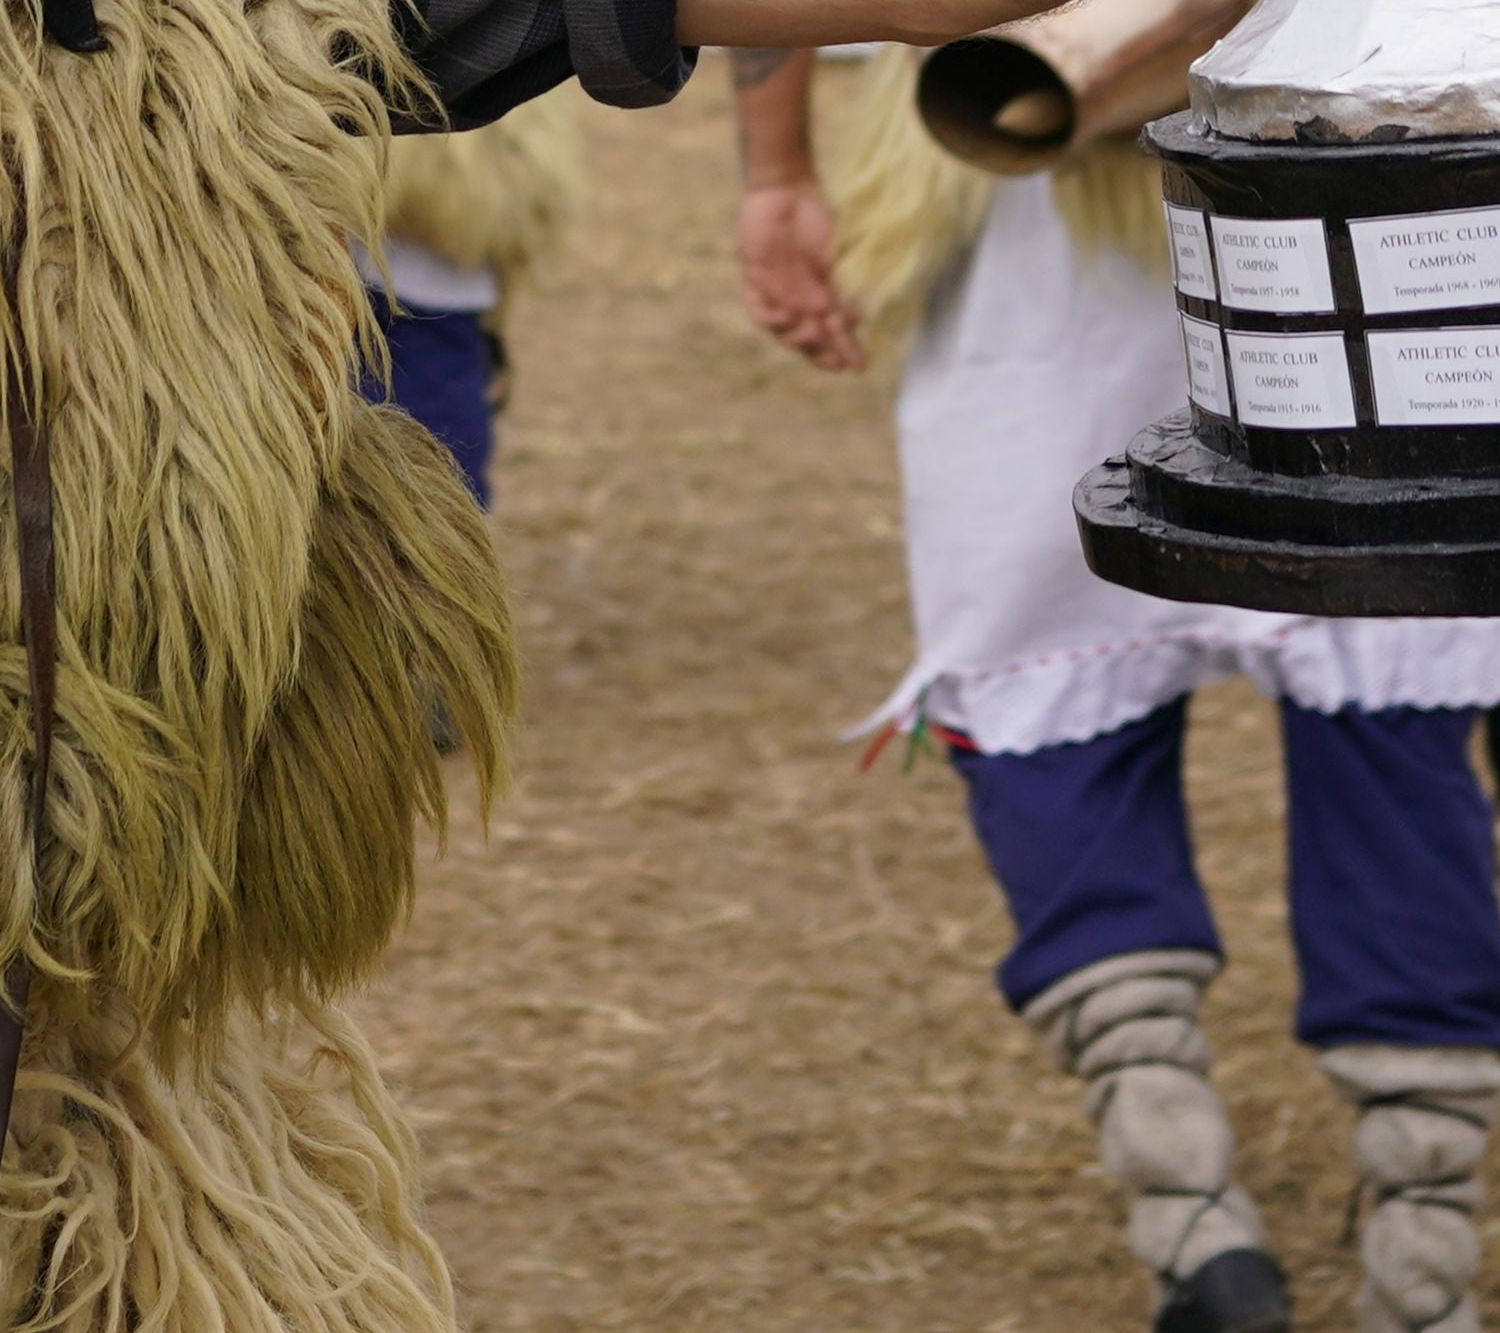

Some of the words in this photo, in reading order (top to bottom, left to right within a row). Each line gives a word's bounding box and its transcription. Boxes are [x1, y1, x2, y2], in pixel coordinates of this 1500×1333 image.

[1223, 235, 1260, 248] ATHLETIC
[1264, 237, 1297, 248] CLUB
[1380, 230, 1449, 249] ATHLETIC
[1457, 226, 1498, 241] CLUB
[1237, 259, 1278, 271] CAMPEÓN
[1409, 251, 1477, 270] CAMPEÓN
[1231, 284, 1258, 295] Temporada
[1394, 282, 1443, 297] Temporada
[1240, 351, 1278, 365] ATHLETIC
[1283, 352, 1318, 365] CLUB
[1398, 346, 1468, 361] ATHLETIC
[1255, 375, 1299, 388] CAMPEÓN
[1425, 370, 1492, 384] CAMPEÓN
[1248, 401, 1276, 413] Temporada
[1409, 400, 1458, 412] Temporada
